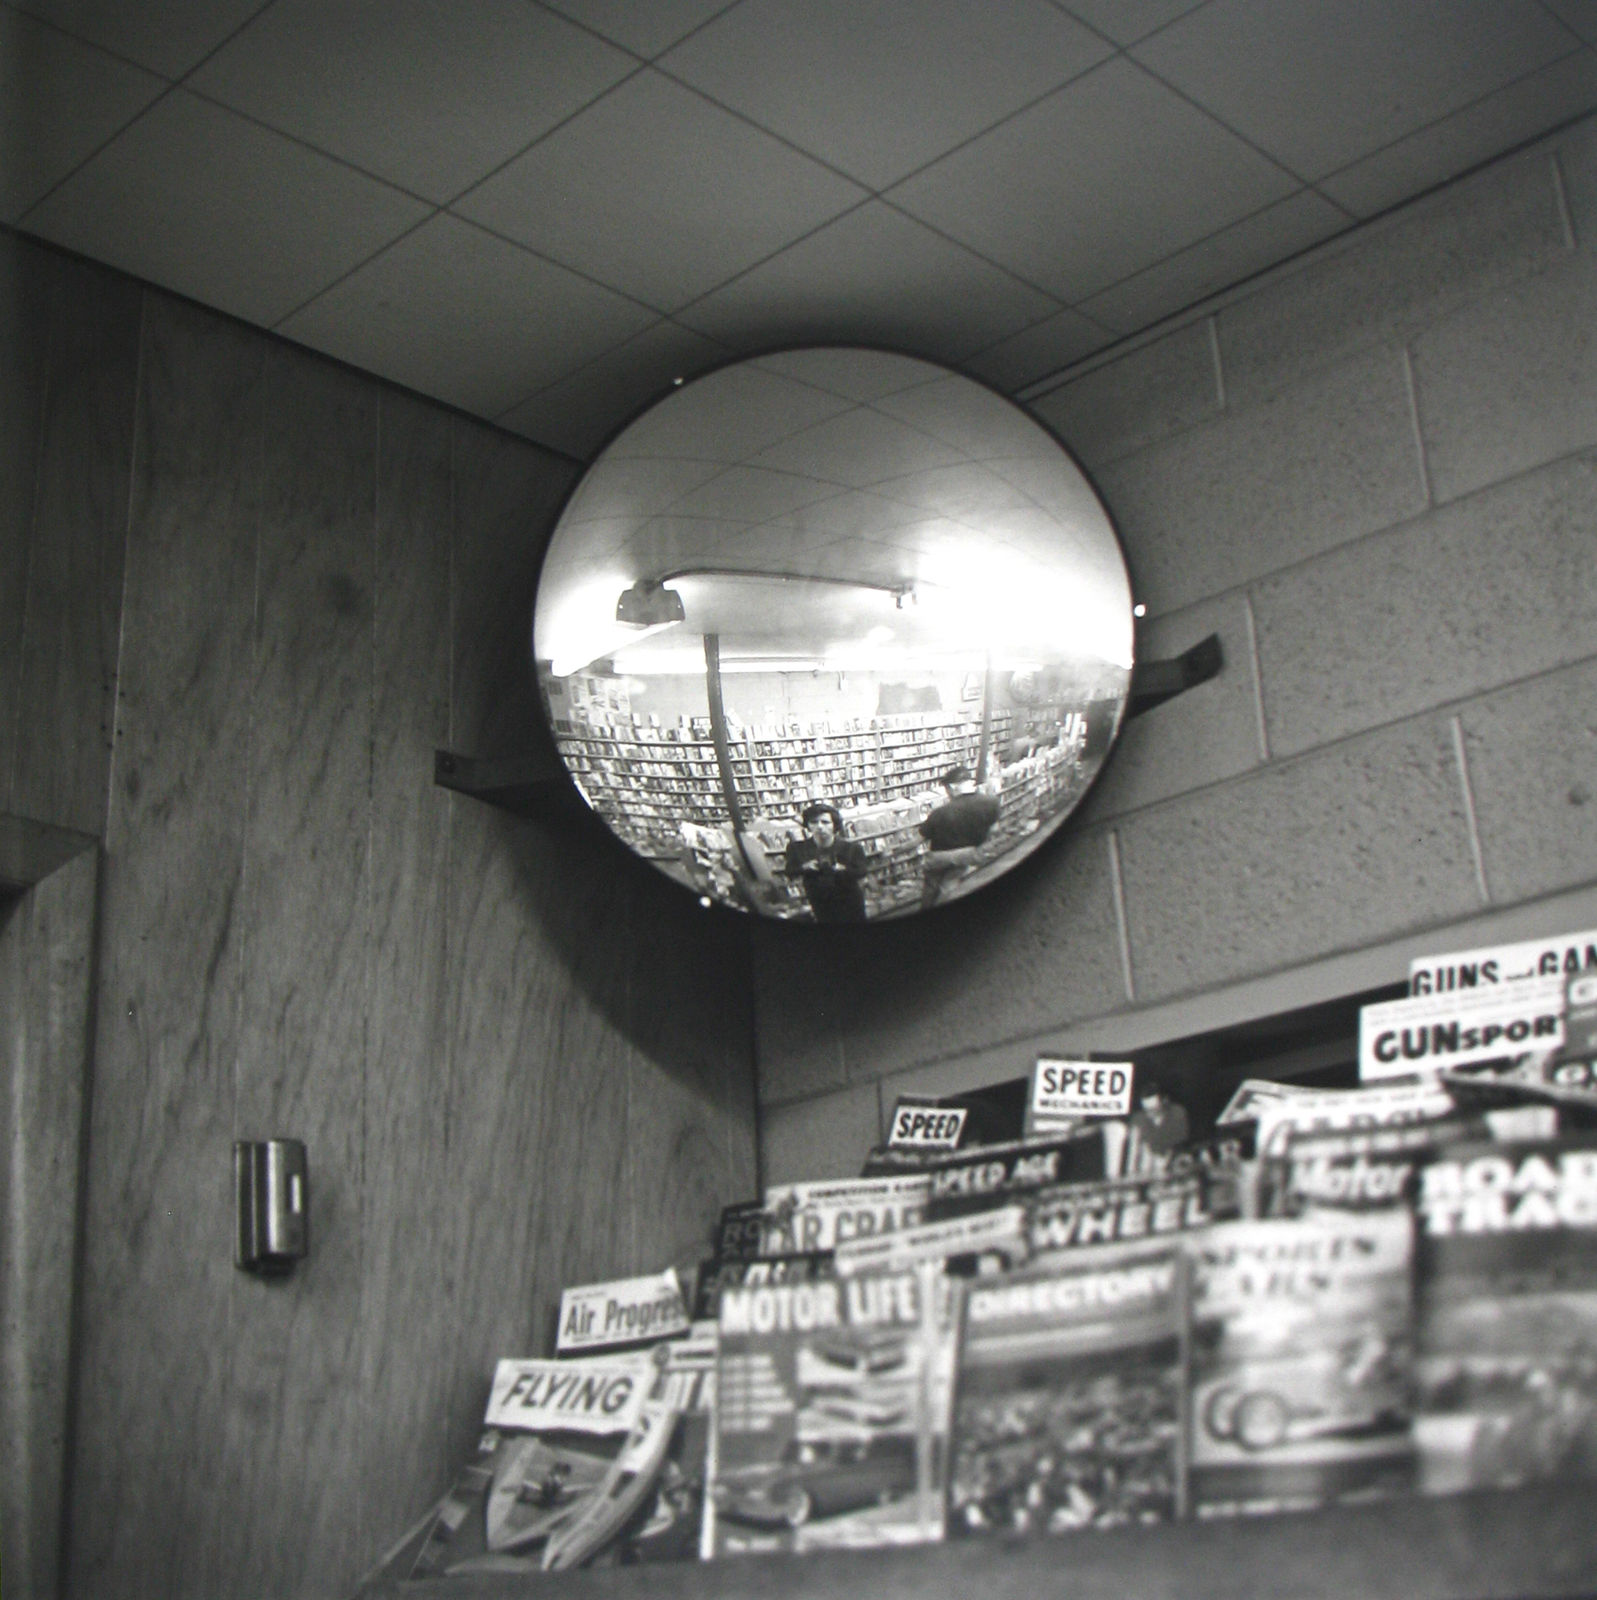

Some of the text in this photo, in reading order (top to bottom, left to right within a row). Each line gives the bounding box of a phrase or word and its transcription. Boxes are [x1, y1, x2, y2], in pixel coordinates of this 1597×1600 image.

[1373, 1013, 1563, 1064] GUNSPOR
[1043, 1067, 1127, 1096] SPEED
[1038, 1098, 1123, 1111] MECHANICS
[897, 1112, 961, 1140] SPEED
[564, 1304, 597, 1337] Air
[719, 1282, 839, 1334] MOTOR
[847, 1275, 915, 1326] LIFE
[502, 1372, 634, 1416] FLYING
